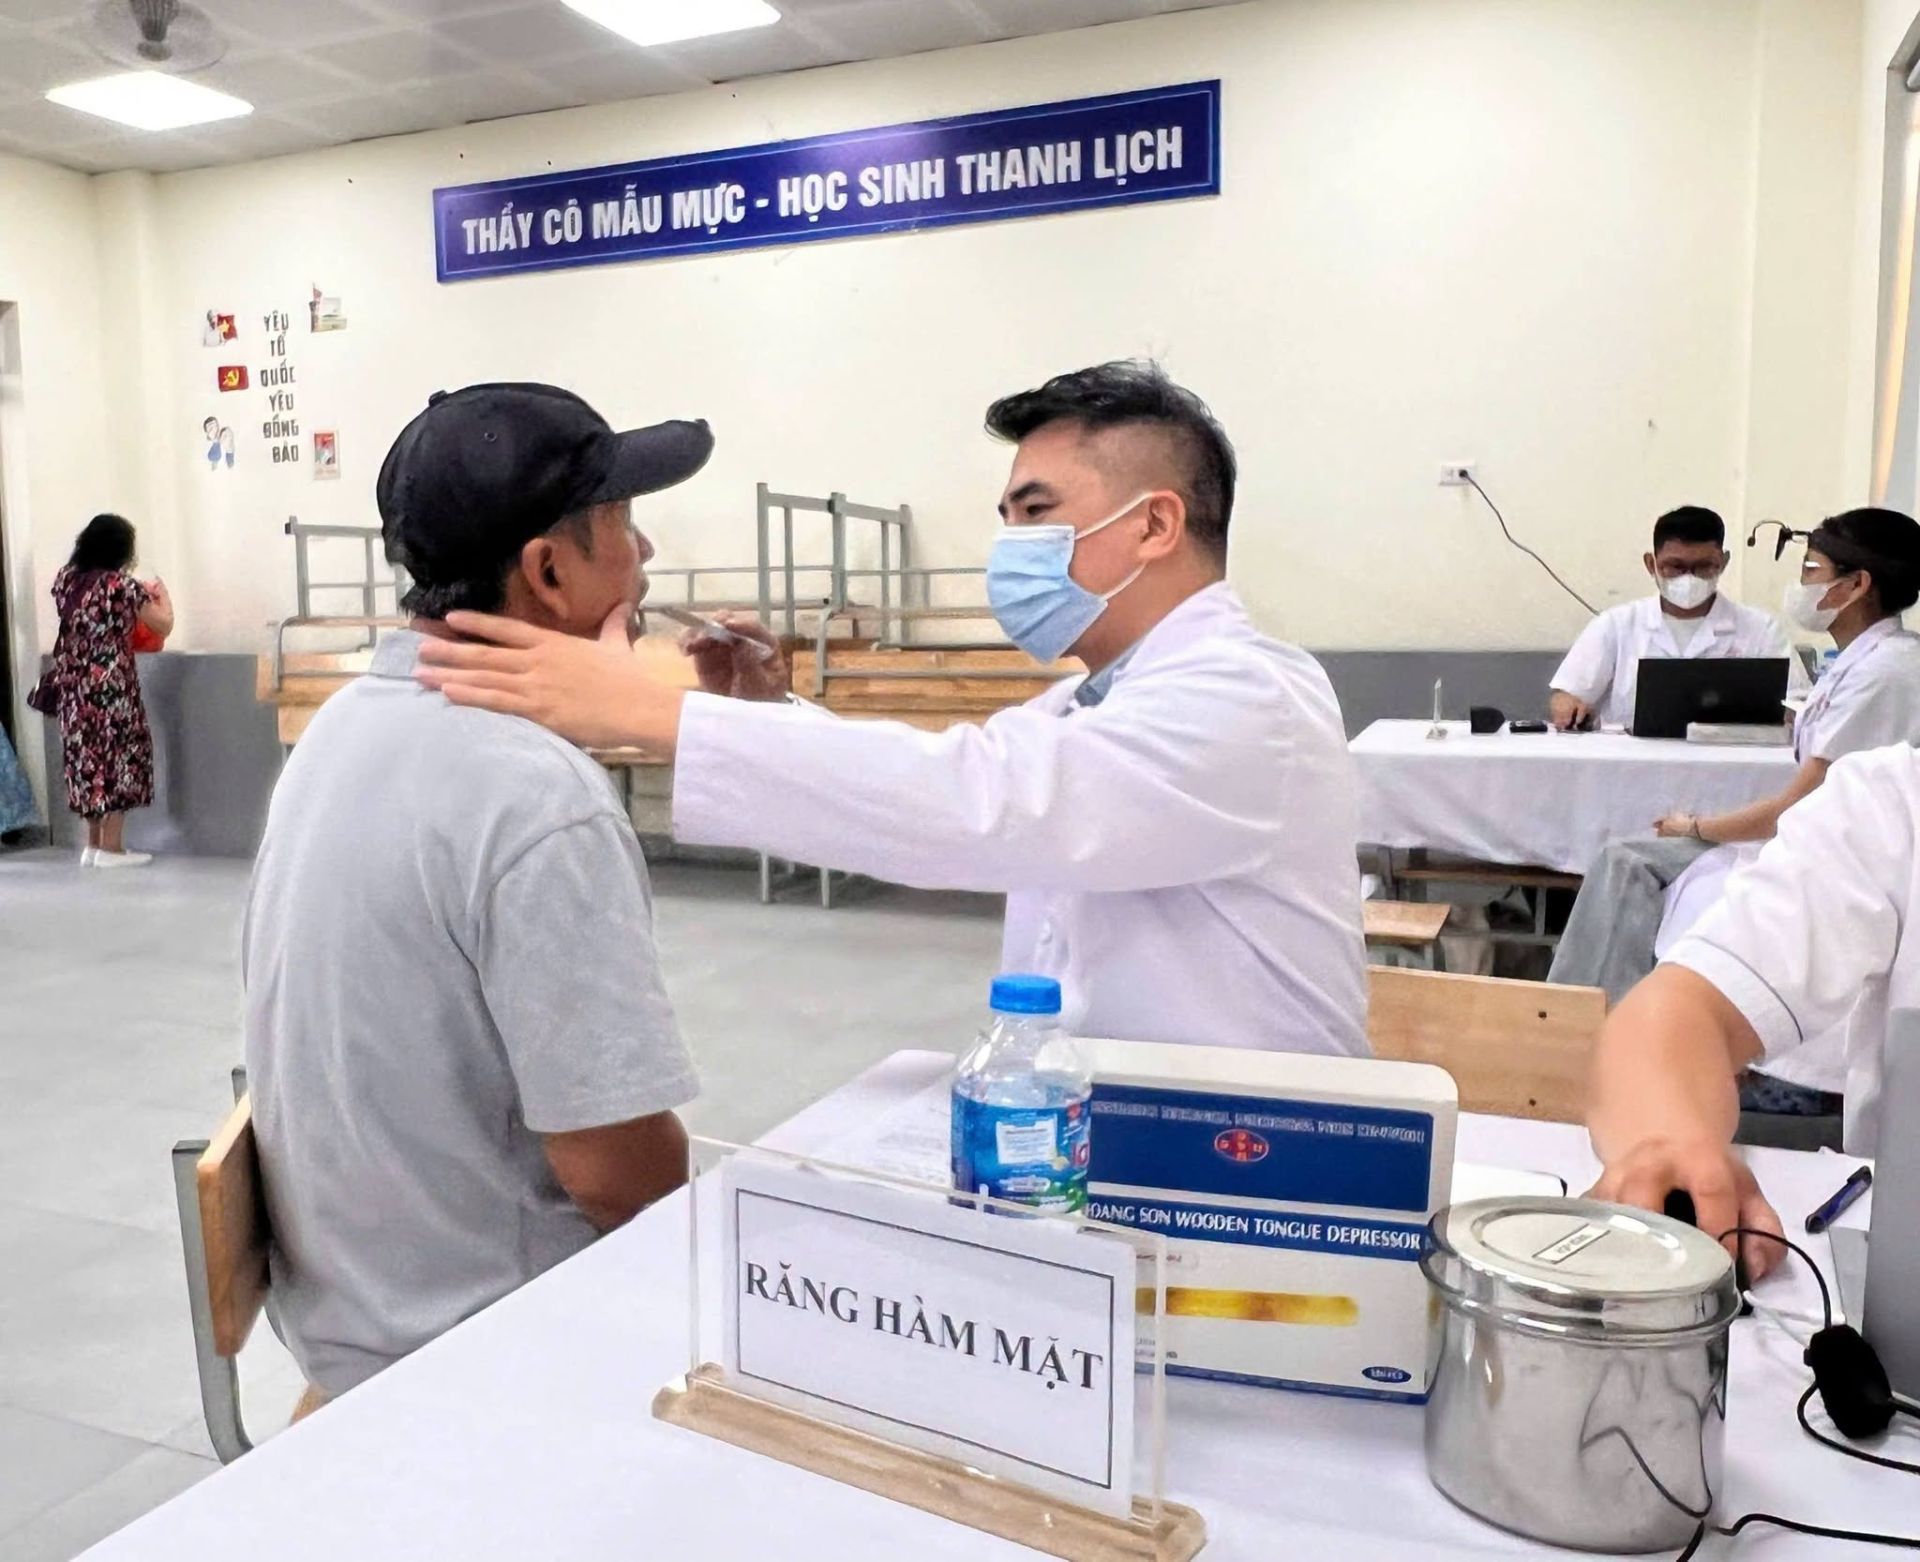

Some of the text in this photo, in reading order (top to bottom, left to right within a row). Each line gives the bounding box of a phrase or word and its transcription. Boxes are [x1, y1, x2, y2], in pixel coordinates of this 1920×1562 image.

[543, 199, 583, 245] CÔ
[592, 184, 662, 239] MẪU
[672, 183, 745, 234] MỰC
[755, 197, 770, 209] -
[778, 171, 848, 222] HỌC
[857, 159, 945, 208] SINH
[956, 141, 1081, 195] THANH
[1094, 126, 1182, 185] LỊCH
[263, 310, 289, 332] YÊU
[269, 390, 294, 412] YÊU
[1175, 1211, 1249, 1234] WOODEN
[1254, 1218, 1321, 1240] TONGUE
[1327, 1225, 1421, 1250] DEPRESSOR
[745, 1261, 1103, 1390] RĂNG HÀM MẶT
